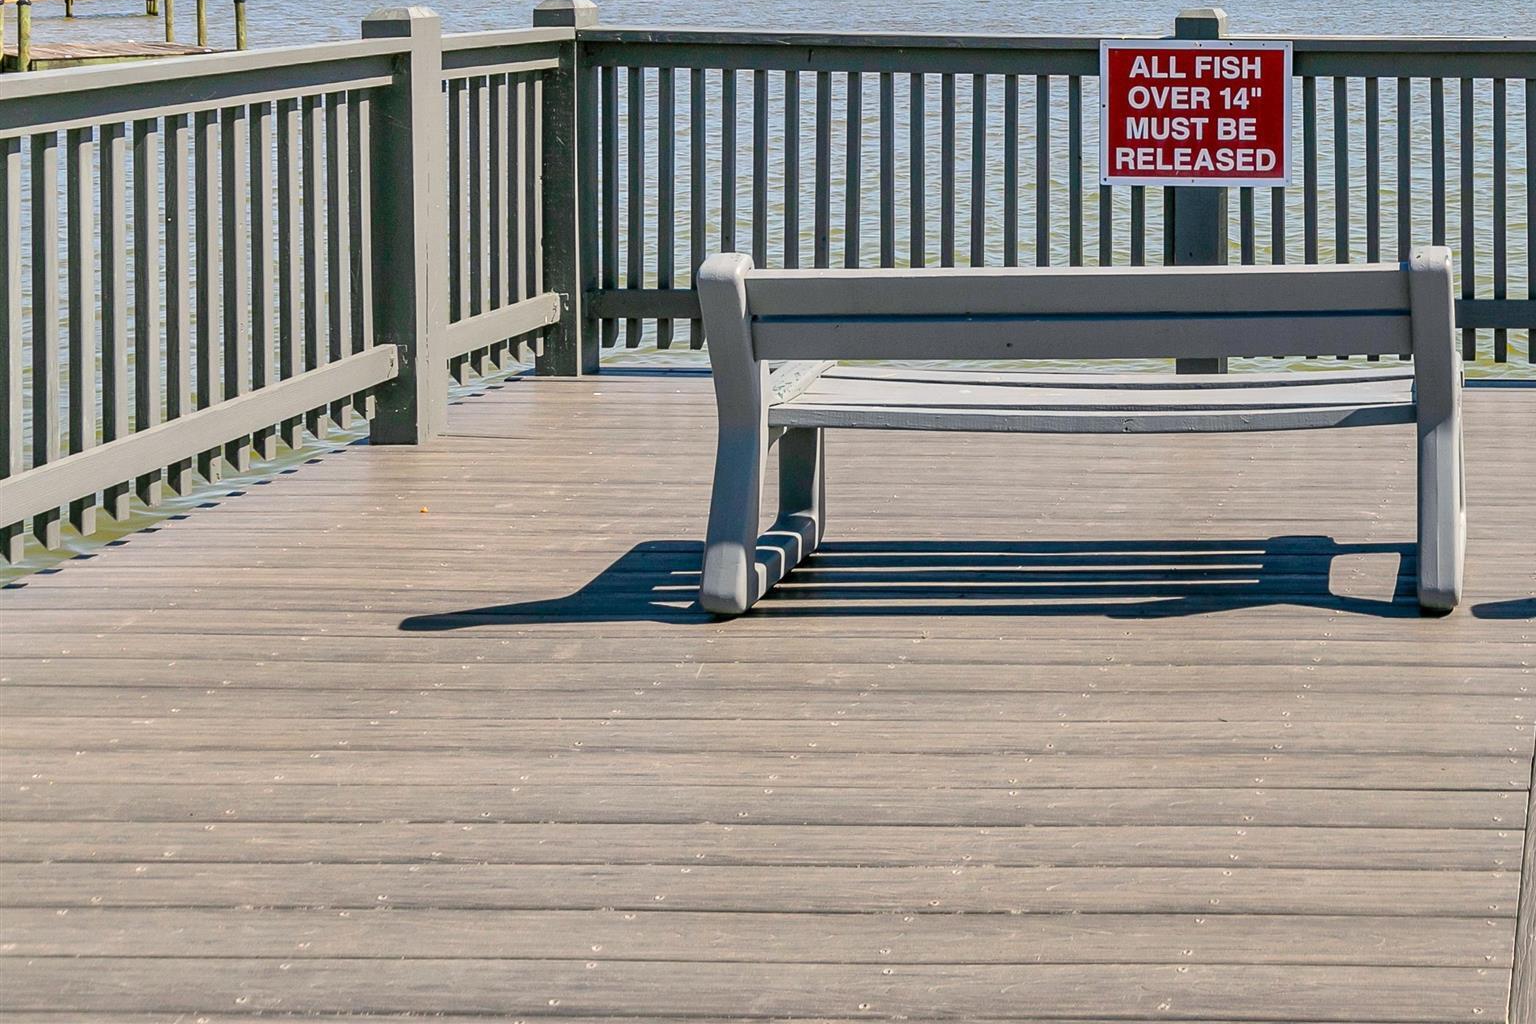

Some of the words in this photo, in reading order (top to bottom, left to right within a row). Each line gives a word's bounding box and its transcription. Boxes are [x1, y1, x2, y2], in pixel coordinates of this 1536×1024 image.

[1129, 56, 1186, 78] ALL
[1196, 56, 1261, 79] FISH
[1128, 86, 1210, 109] OVER
[1220, 88, 1261, 109] 14"
[1127, 117, 1208, 140] MUST
[1218, 118, 1256, 140] BE
[1116, 148, 1276, 171] RELEASED
